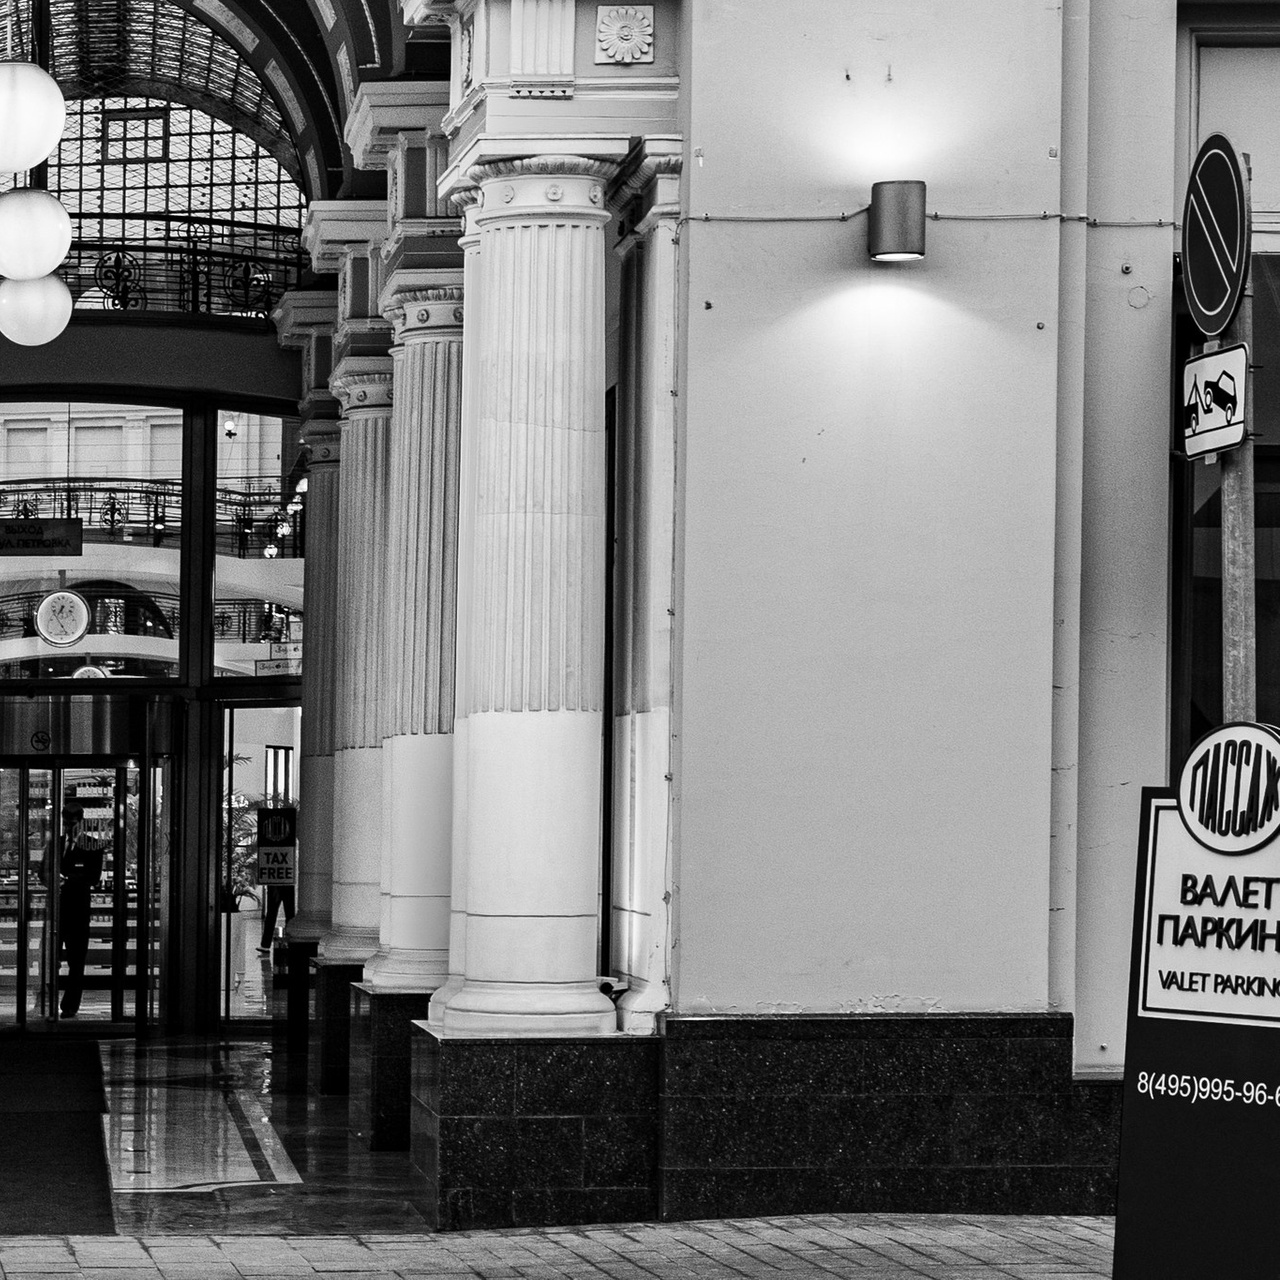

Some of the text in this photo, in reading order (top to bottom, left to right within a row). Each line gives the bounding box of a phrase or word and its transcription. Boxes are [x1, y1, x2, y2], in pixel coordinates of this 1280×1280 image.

[4, 525, 44, 535] ВЫХОД
[1189, 739, 1280, 838] ПАССАЖ
[264, 852, 288, 864] TAX
[260, 867, 293, 879] FREE
[1180, 873, 1280, 910] ВАЛЕТ
[1158, 970, 1211, 992] VALET
